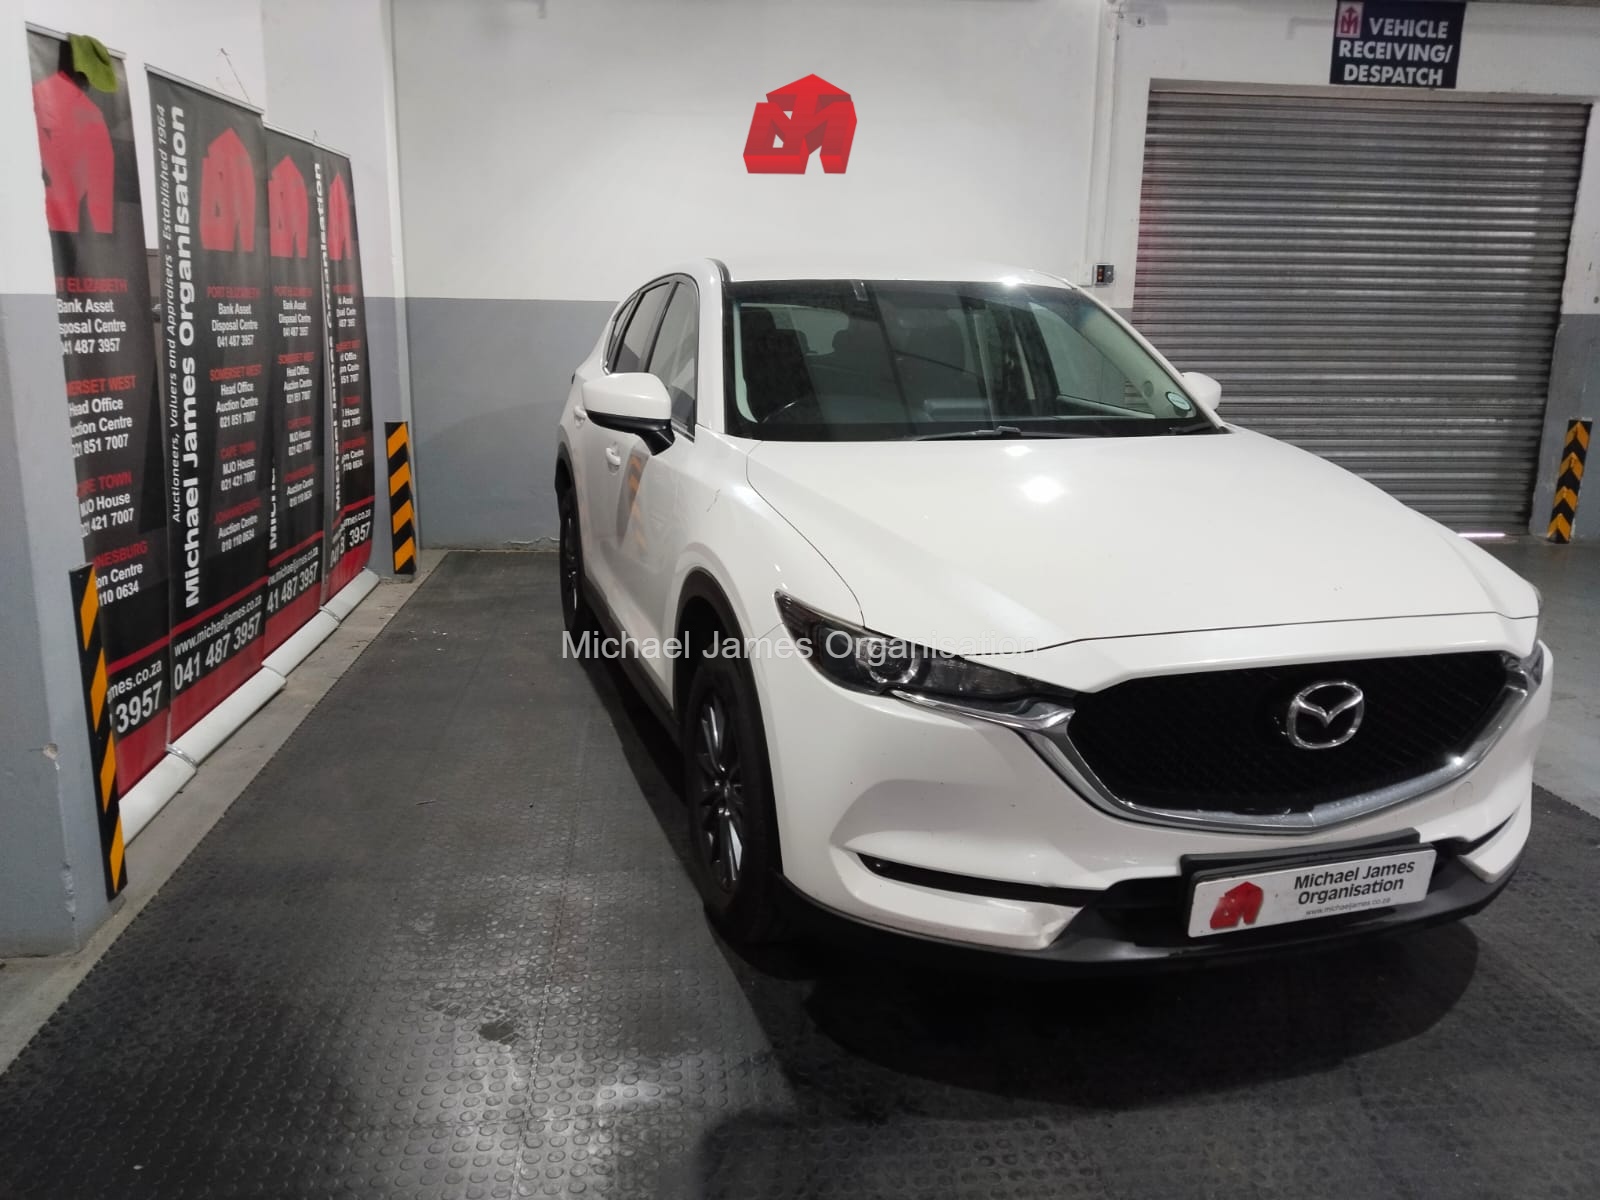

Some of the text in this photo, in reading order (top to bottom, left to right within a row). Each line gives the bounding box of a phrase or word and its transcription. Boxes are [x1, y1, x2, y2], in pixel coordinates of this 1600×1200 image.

[1369, 17, 1449, 39] VEHICLE
[1338, 39, 1453, 63] RECEIVING/
[1343, 63, 1444, 86] DESPATCH
[155, 104, 167, 144] 1964
[158, 149, 172, 240] Established
[56, 298, 115, 313] Bank Asset
[165, 254, 177, 336] Appraisers
[59, 318, 127, 337] sposal Centre
[211, 319, 238, 333] Disposal
[74, 338, 96, 354] 487
[98, 338, 121, 353] 3957
[167, 339, 178, 369] and
[170, 106, 200, 608] Michael James Organisation
[108, 375, 136, 391] WEST
[220, 381, 254, 396] Head Office
[91, 396, 124, 413] Office
[168, 372, 179, 429] Valuers
[215, 396, 259, 413] Auction Centre
[99, 416, 133, 432] Centre
[83, 438, 102, 454] 851
[105, 433, 129, 451] 7007
[98, 471, 132, 490] TOWN
[170, 433, 181, 523] Auctioneers,
[97, 493, 131, 510] House
[91, 514, 108, 531] 421
[111, 508, 135, 526] 7007
[217, 521, 241, 539] Auction
[348, 521, 371, 547] 3957
[110, 563, 144, 583] Centre
[116, 580, 140, 601] 0634
[266, 560, 319, 613] 41 487 3957
[173, 611, 262, 691] 041 487 3957
[115, 680, 163, 734] 3957
[1294, 861, 1415, 889] Michael James
[1298, 879, 1404, 904] Organisation
